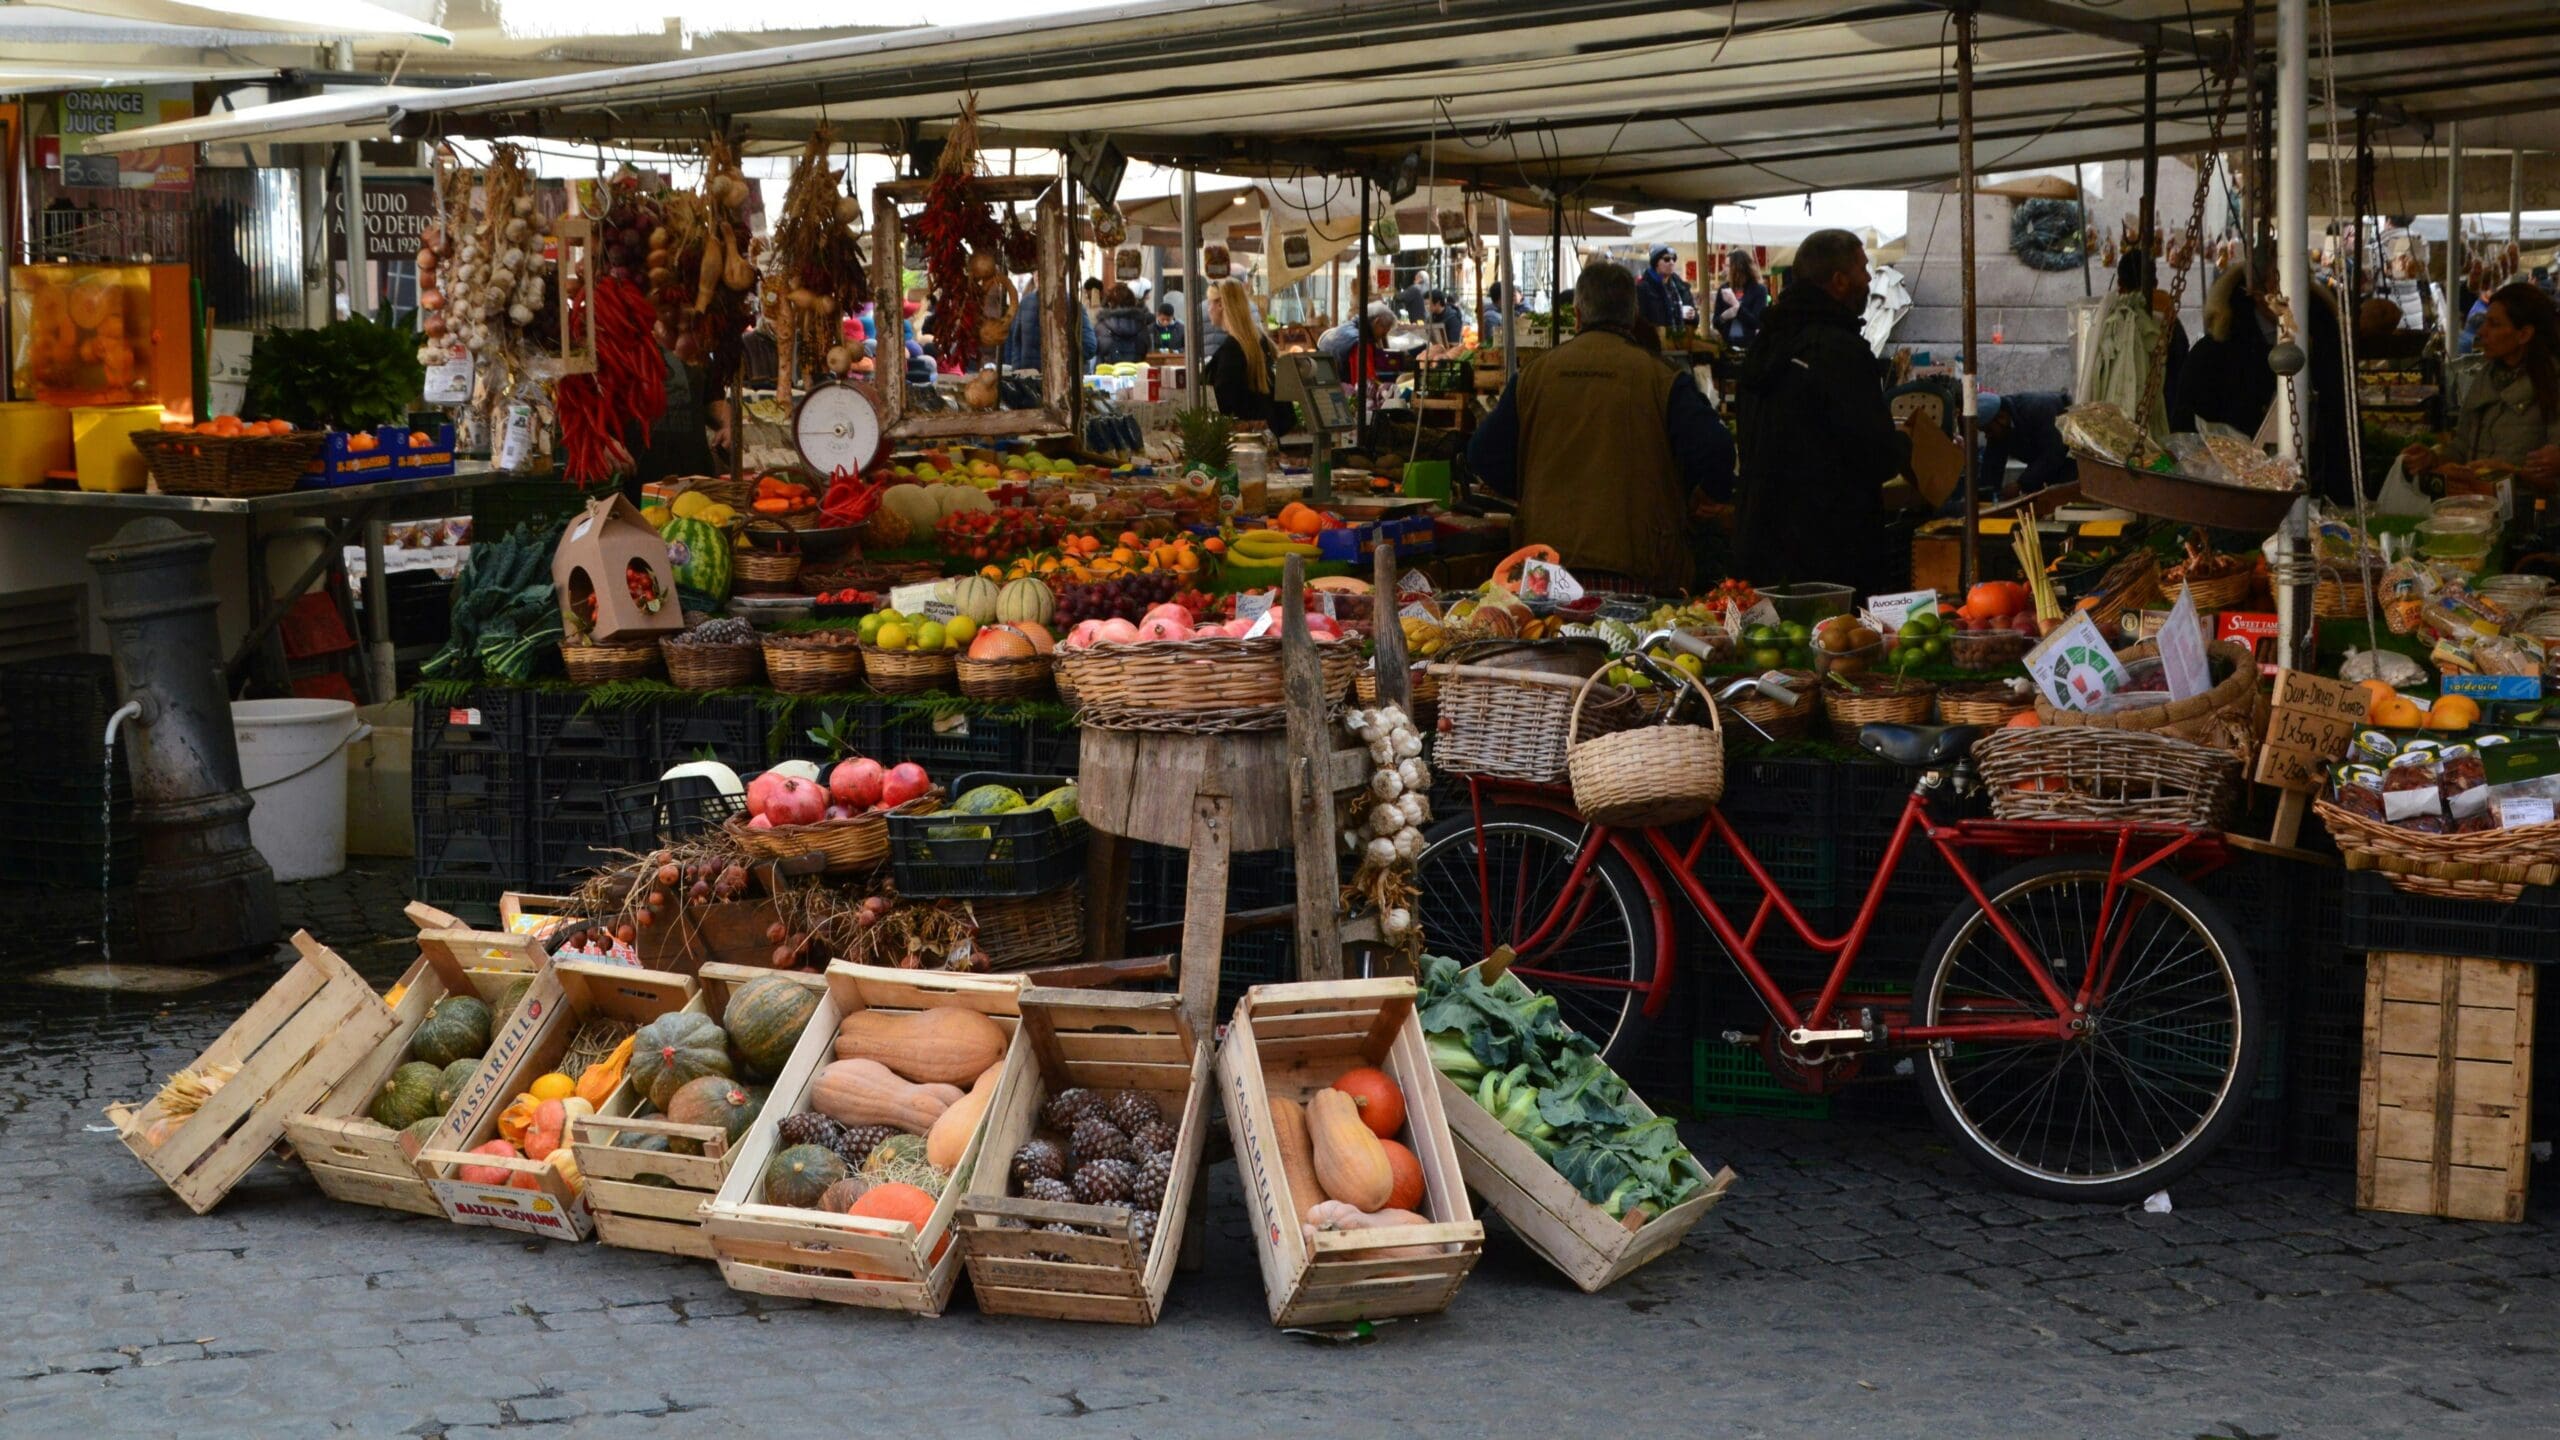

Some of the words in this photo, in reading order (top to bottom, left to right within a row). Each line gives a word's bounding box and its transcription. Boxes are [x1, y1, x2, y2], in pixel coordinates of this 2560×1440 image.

[65, 91, 143, 114] ORANGE
[65, 113, 116, 133] JUICE
[335, 192, 408, 213] CUDIO
[370, 237, 394, 253] DAL
[397, 236, 421, 253] 1929
[1872, 596, 1913, 609] Avocado
[2262, 620, 2280, 630] TAM
[2284, 672, 2335, 707] SUN-DRIED
[2337, 684, 2366, 717] TOMATO
